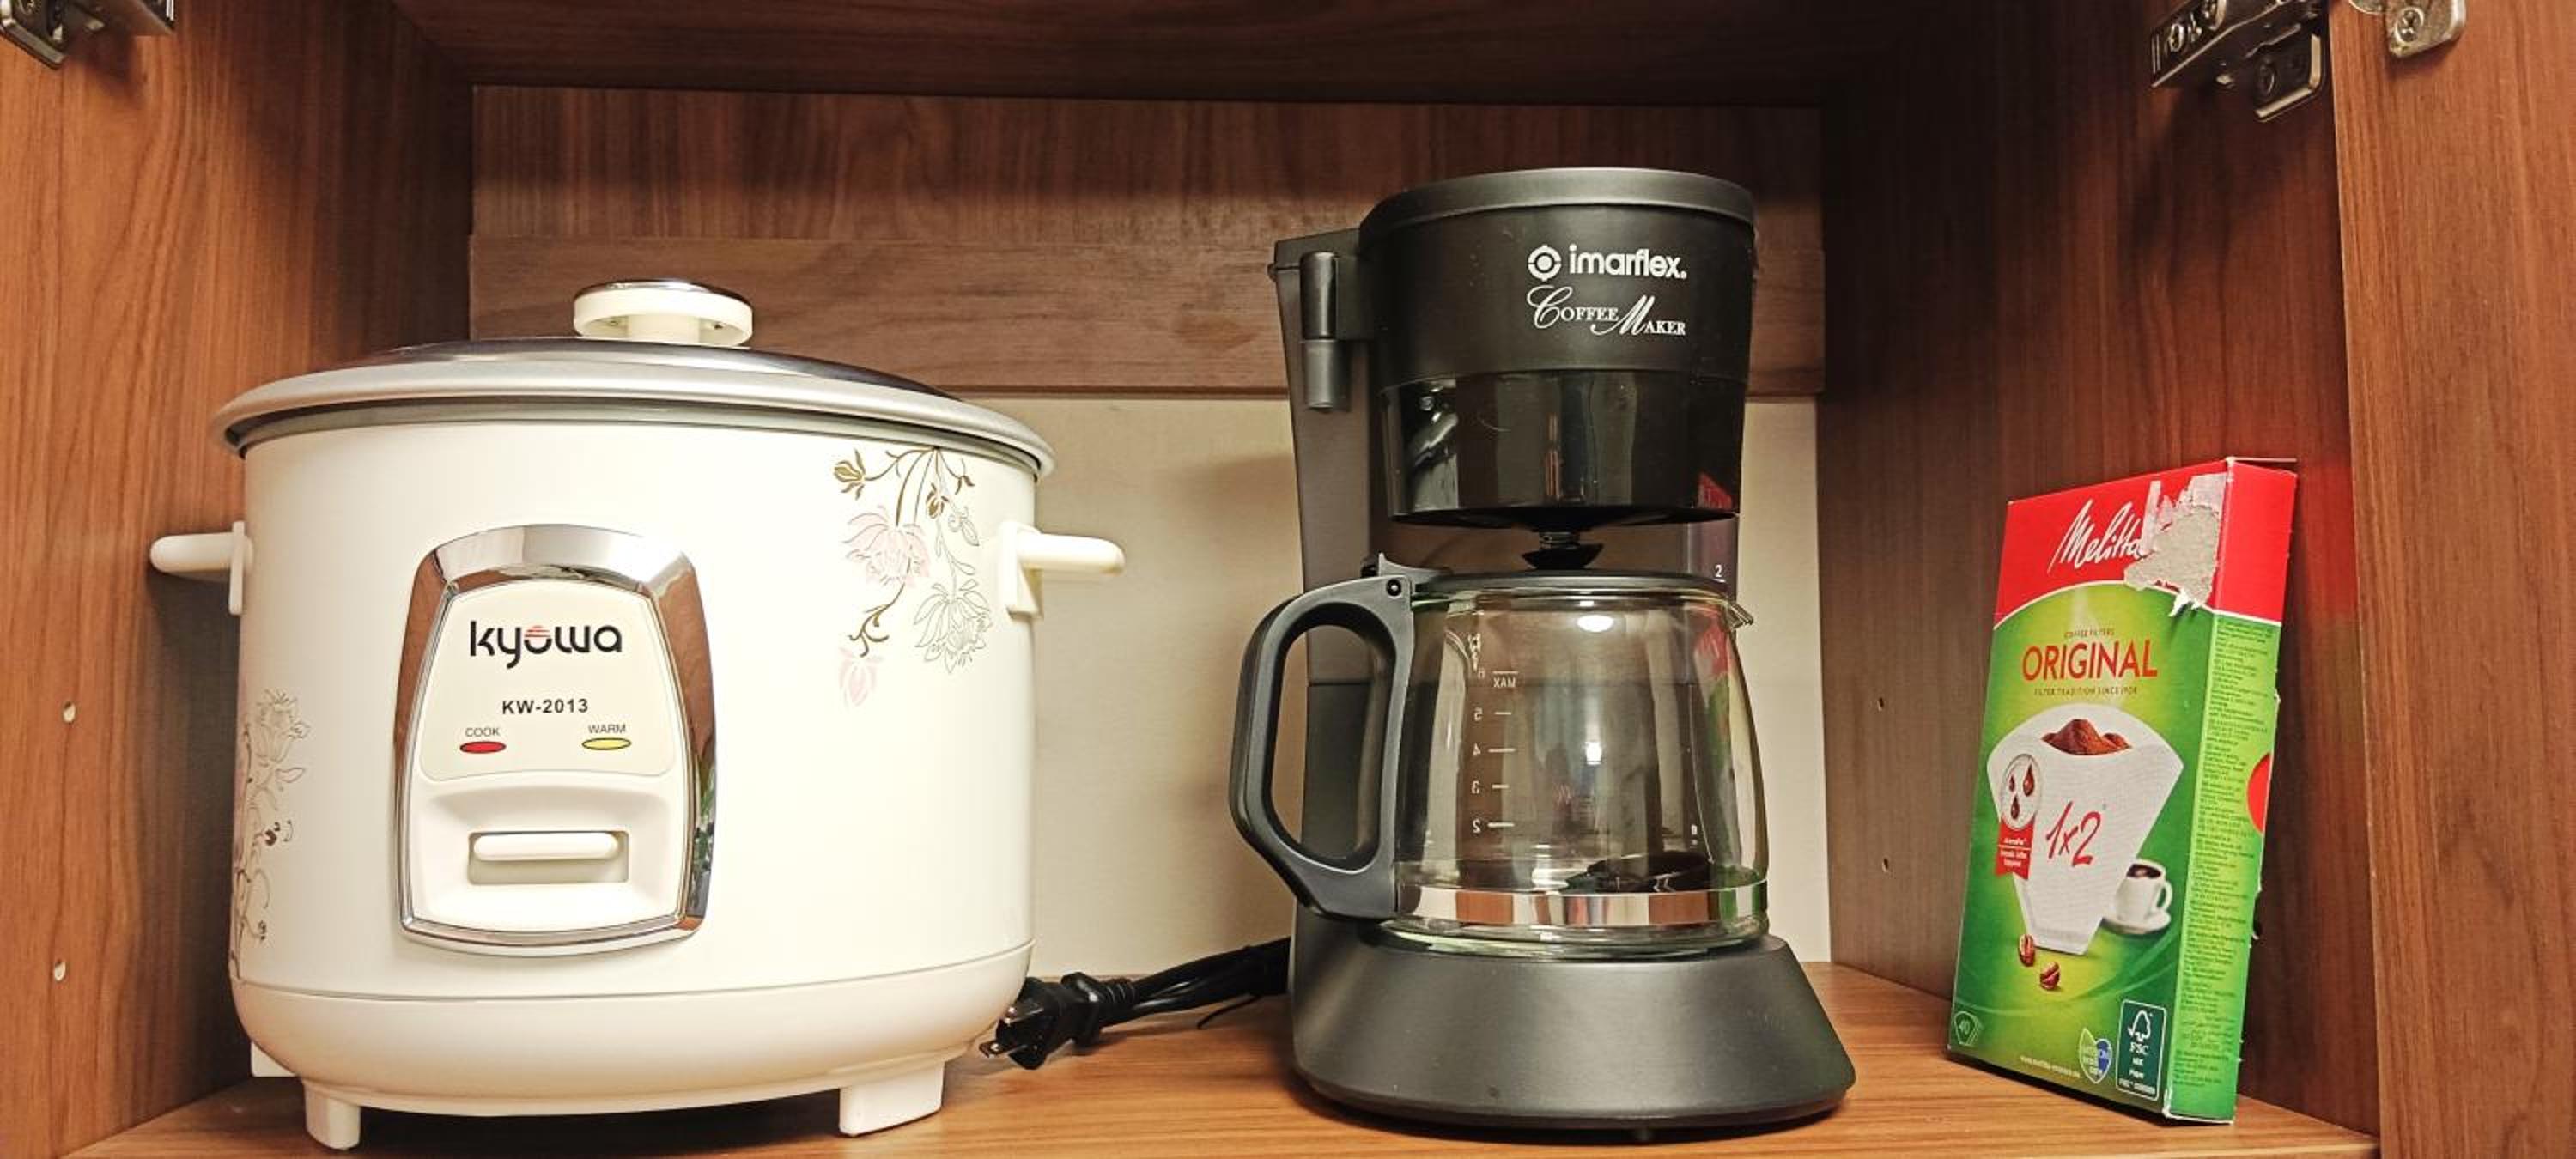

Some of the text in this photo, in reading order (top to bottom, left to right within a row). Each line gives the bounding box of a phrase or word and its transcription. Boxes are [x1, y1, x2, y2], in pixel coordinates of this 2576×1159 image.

[2047, 499, 2147, 574] Melitta
[1715, 564, 1723, 578] 2
[470, 620, 623, 669] kyowa
[2022, 639, 2158, 681] ORIGINAL
[502, 698, 589, 714] KW-2013
[465, 727, 501, 737] COOK
[588, 724, 627, 735] WARM
[2046, 801, 2101, 867] 1x2
